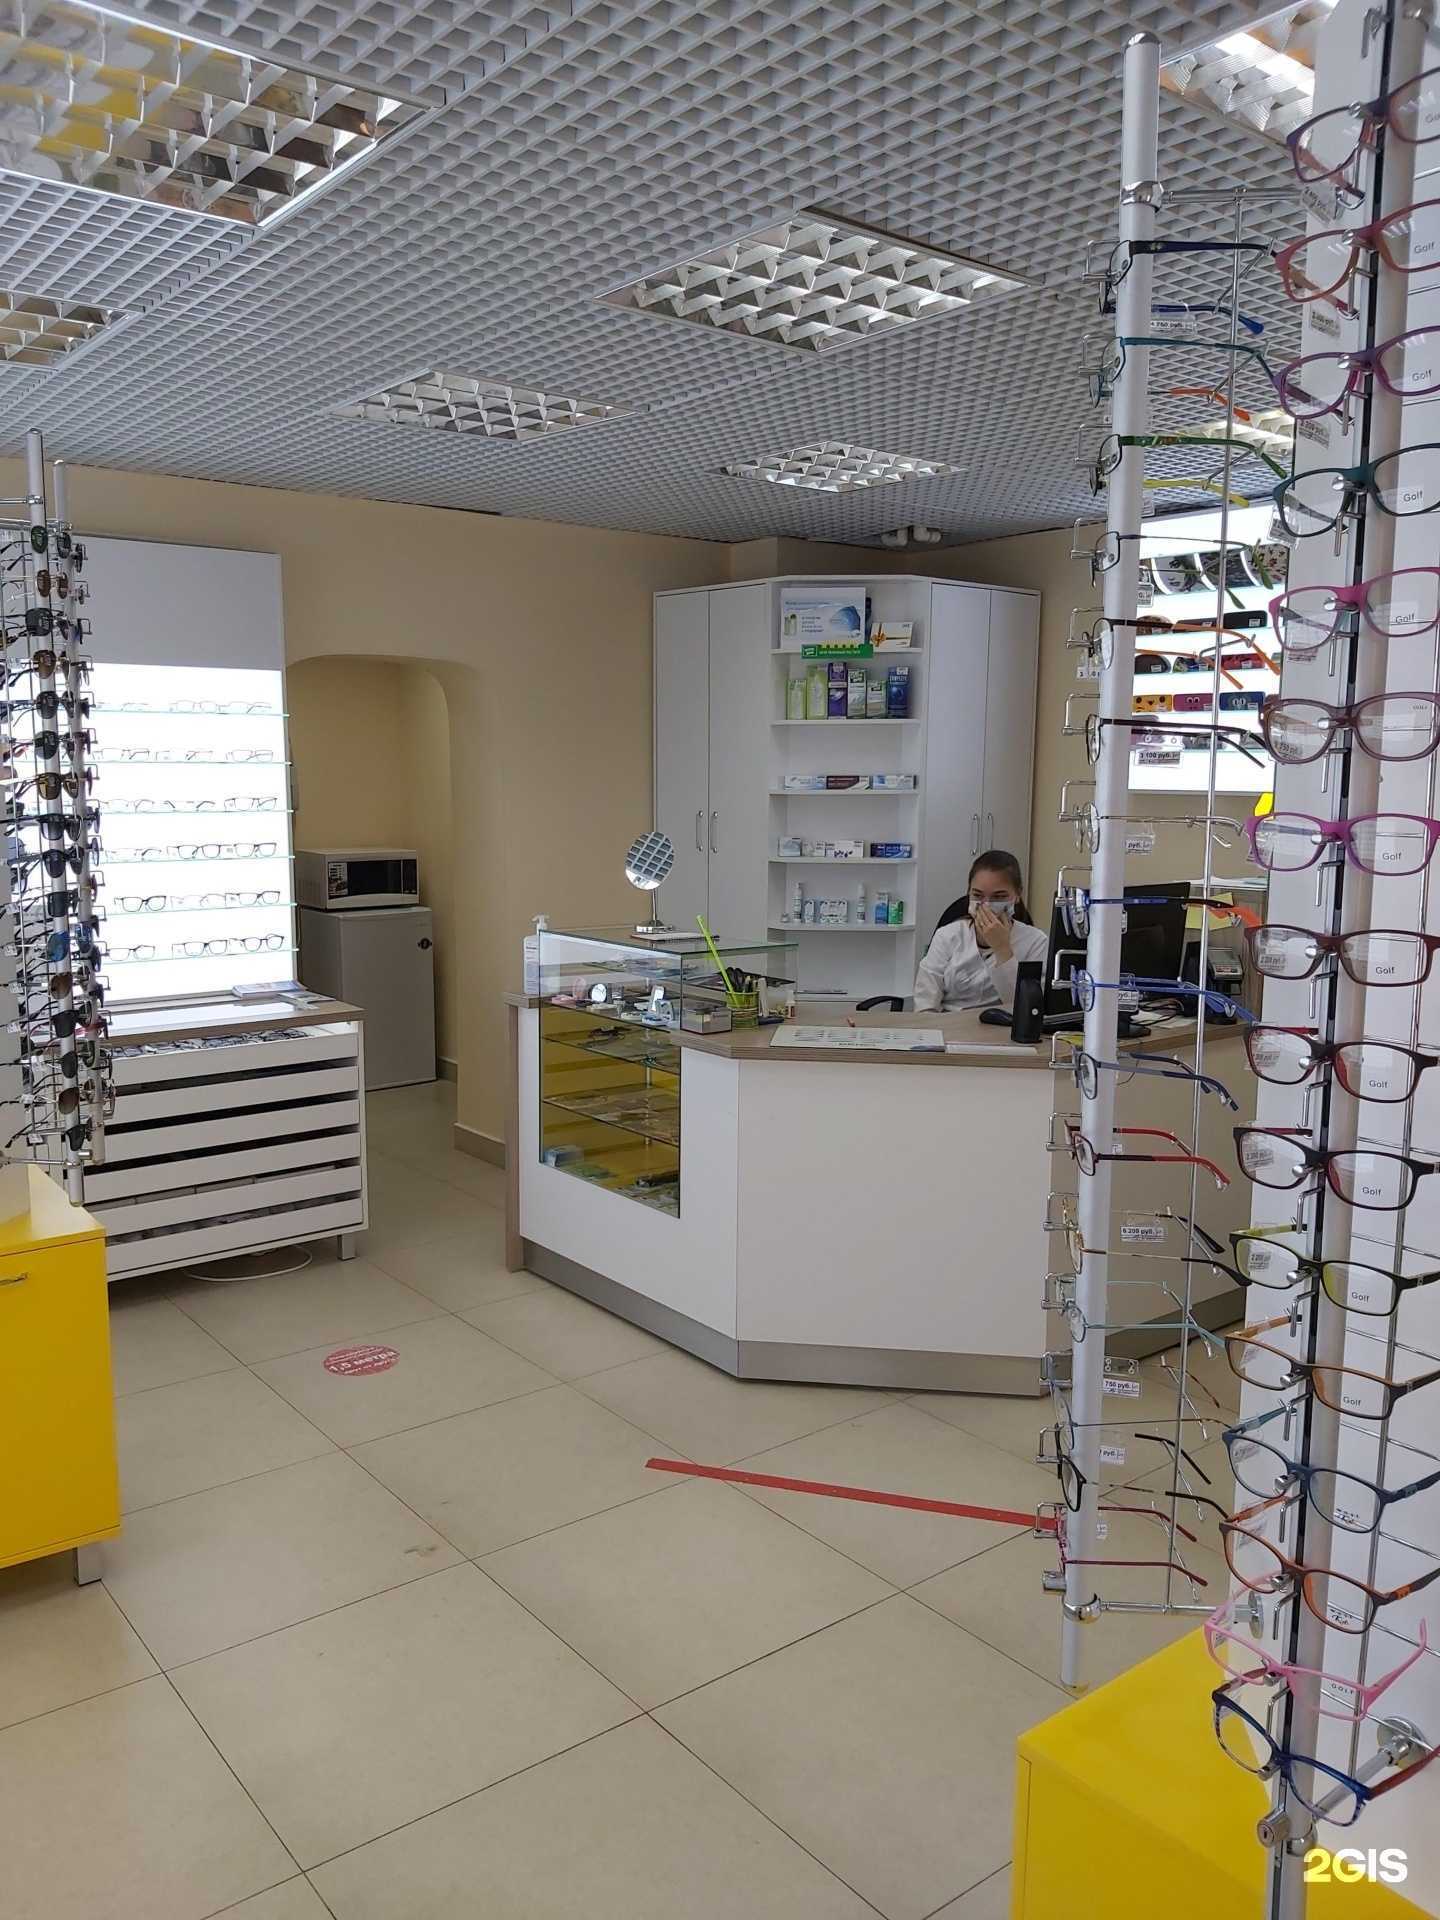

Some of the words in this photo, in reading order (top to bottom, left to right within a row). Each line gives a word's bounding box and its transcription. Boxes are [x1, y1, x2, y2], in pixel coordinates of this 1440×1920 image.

[1414, 241, 1436, 254] Golf
[1412, 369, 1433, 381] Golf
[1403, 490, 1424, 502] Golf
[1382, 851, 1402, 861] Golf
[1375, 966, 1395, 975] Golf
[1369, 1079, 1389, 1089] Golf
[1362, 1186, 1382, 1197] Golf
[1351, 1291, 1370, 1303] Golf
[1343, 1396, 1362, 1407] Golf
